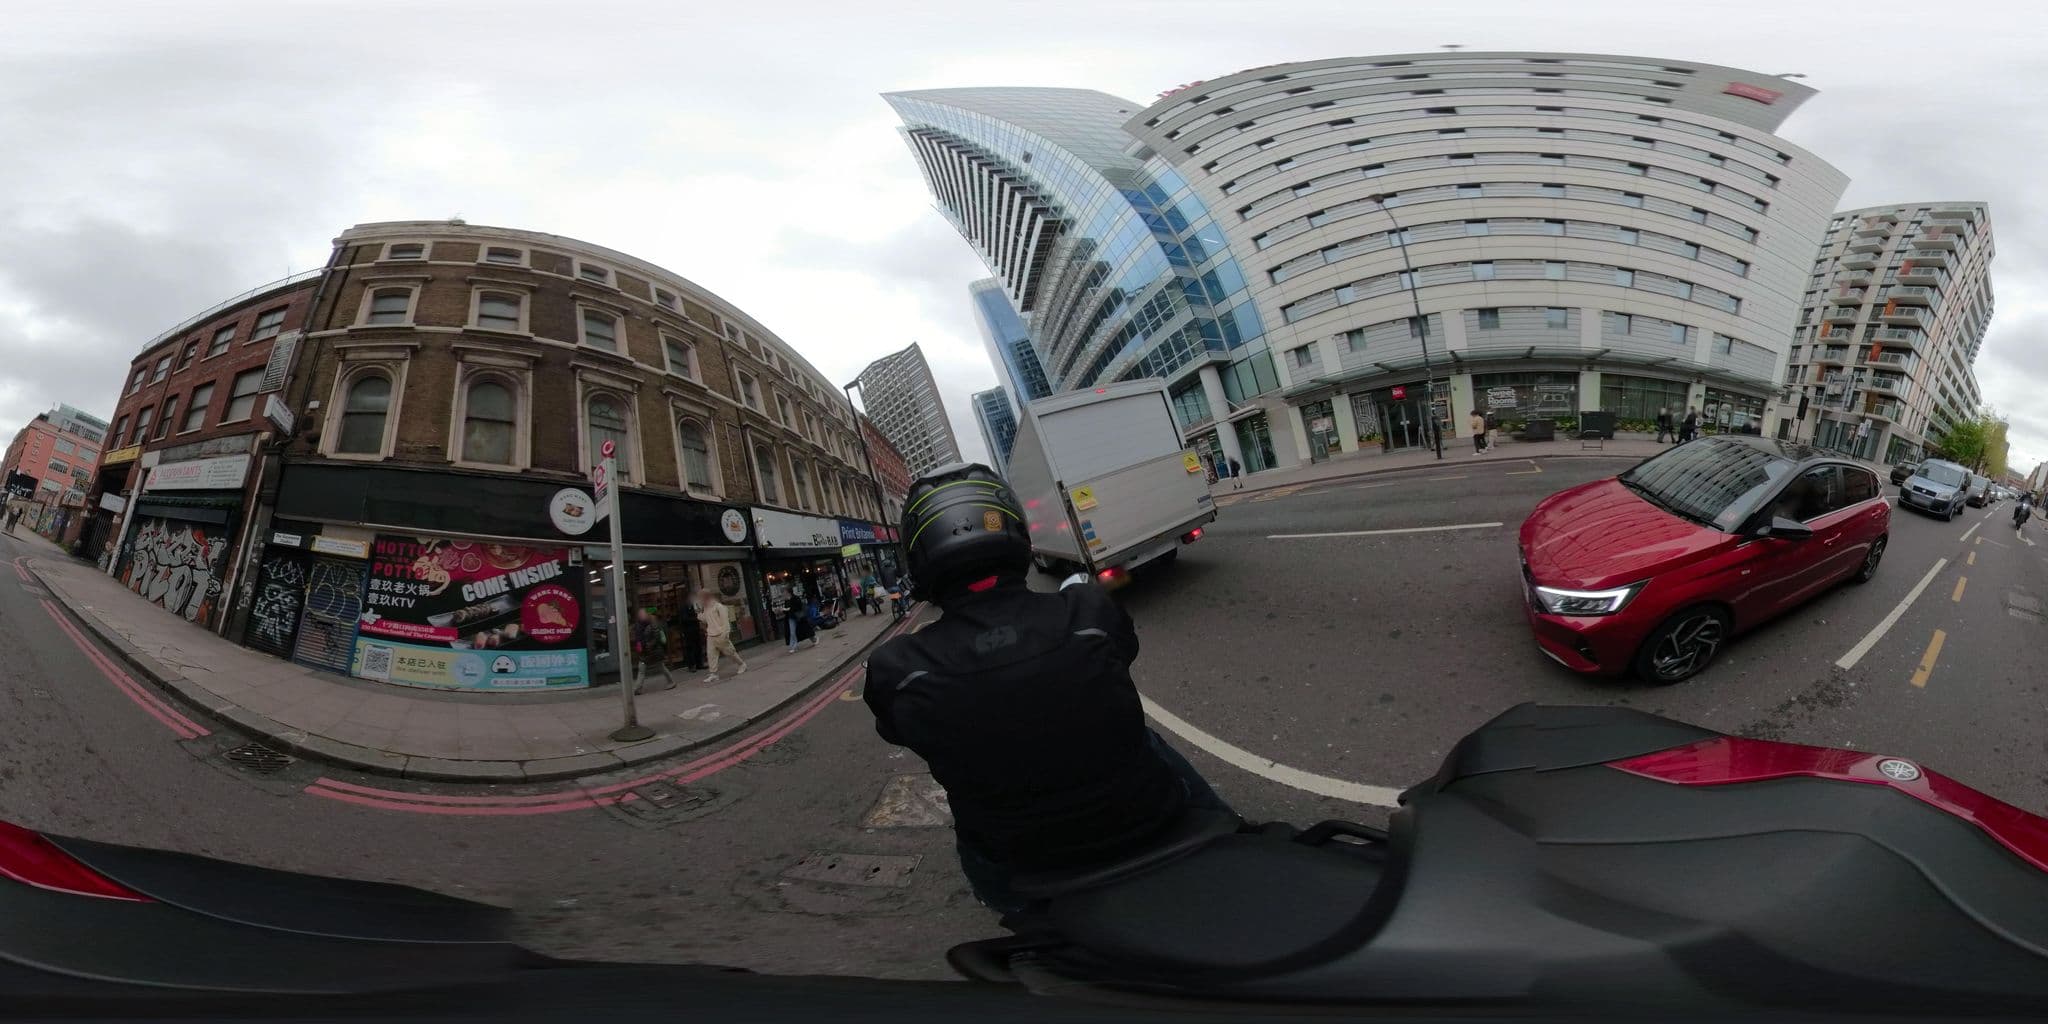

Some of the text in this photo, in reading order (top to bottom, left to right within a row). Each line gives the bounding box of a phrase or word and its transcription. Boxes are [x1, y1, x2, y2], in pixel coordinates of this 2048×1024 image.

[841, 526, 856, 540] Print
[376, 539, 426, 557] HOTTO
[462, 559, 563, 602] COME INSIDE
